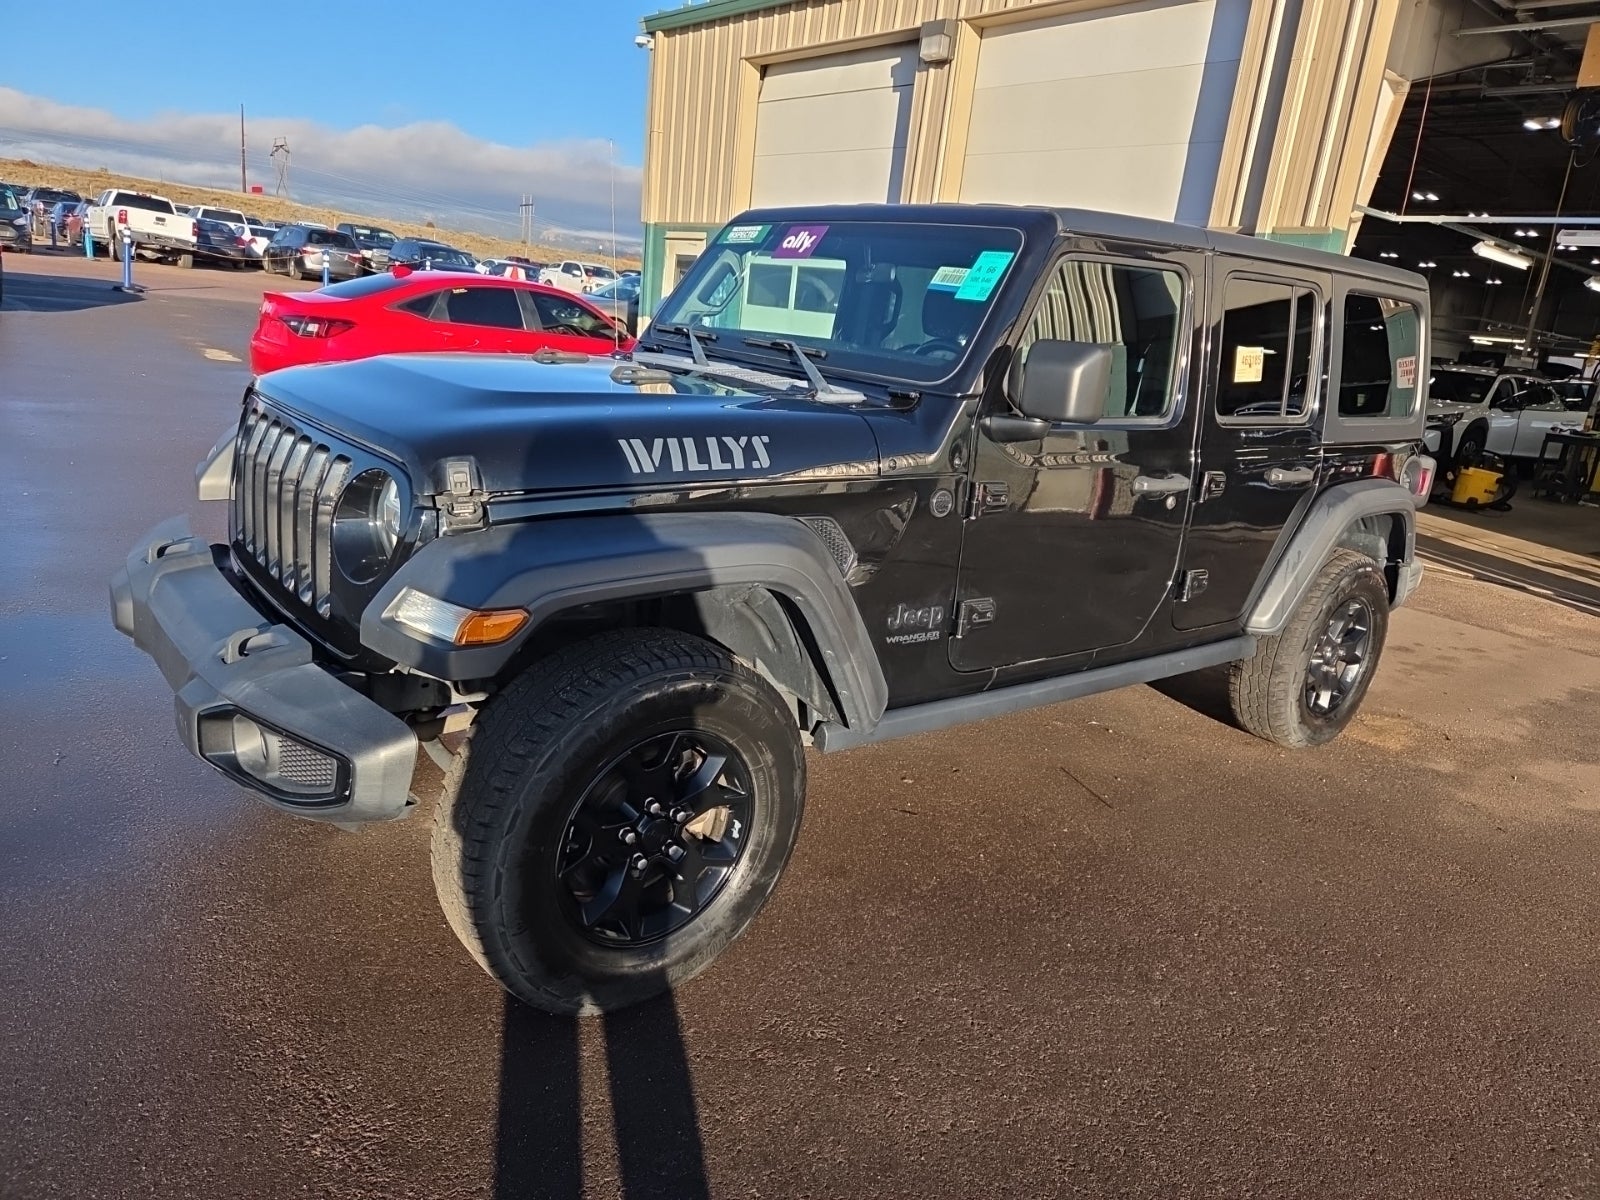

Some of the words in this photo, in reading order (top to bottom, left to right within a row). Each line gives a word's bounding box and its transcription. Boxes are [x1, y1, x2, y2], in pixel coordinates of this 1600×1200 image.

[782, 231, 817, 253] ally
[617, 435, 771, 474] WILLYS
[887, 602, 944, 629] Jeep
[886, 630, 940, 644] WRANGLER
